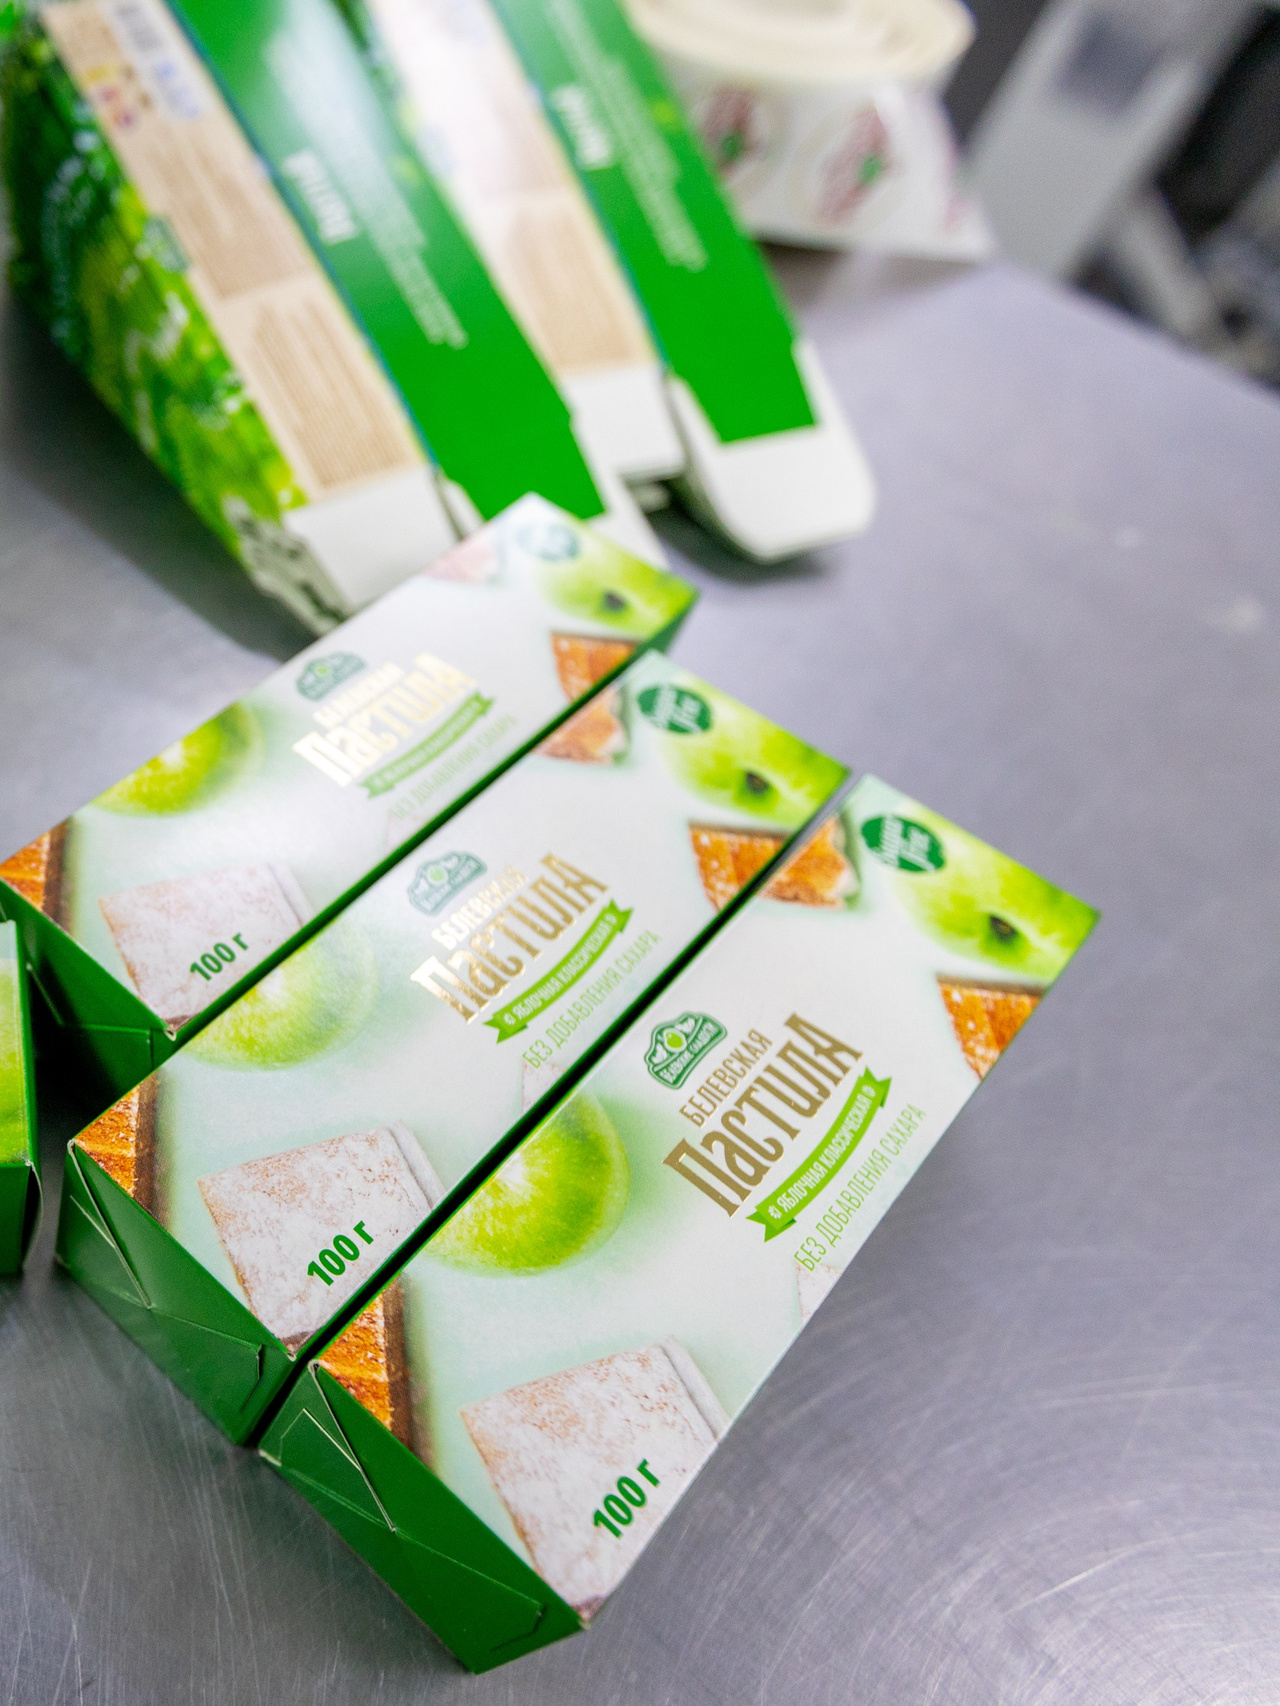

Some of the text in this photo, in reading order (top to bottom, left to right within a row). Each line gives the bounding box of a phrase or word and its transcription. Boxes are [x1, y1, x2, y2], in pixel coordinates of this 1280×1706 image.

[189, 942, 237, 981] 100
[522, 1038, 553, 1069] БЕЗ
[546, 969, 623, 1048] ДОБАВЛЕНИЯ
[678, 1028, 774, 1129] БЕЛЕВСКАЯ
[777, 1092, 873, 1214] ЯБЛОЧНАЯ КЛАССИЧЕСКАЯ
[794, 1103, 927, 1271] БЕЗ ДОБАВЛЕНИЯ САХАРА
[307, 1234, 360, 1286] 100
[593, 1476, 647, 1538] 100
